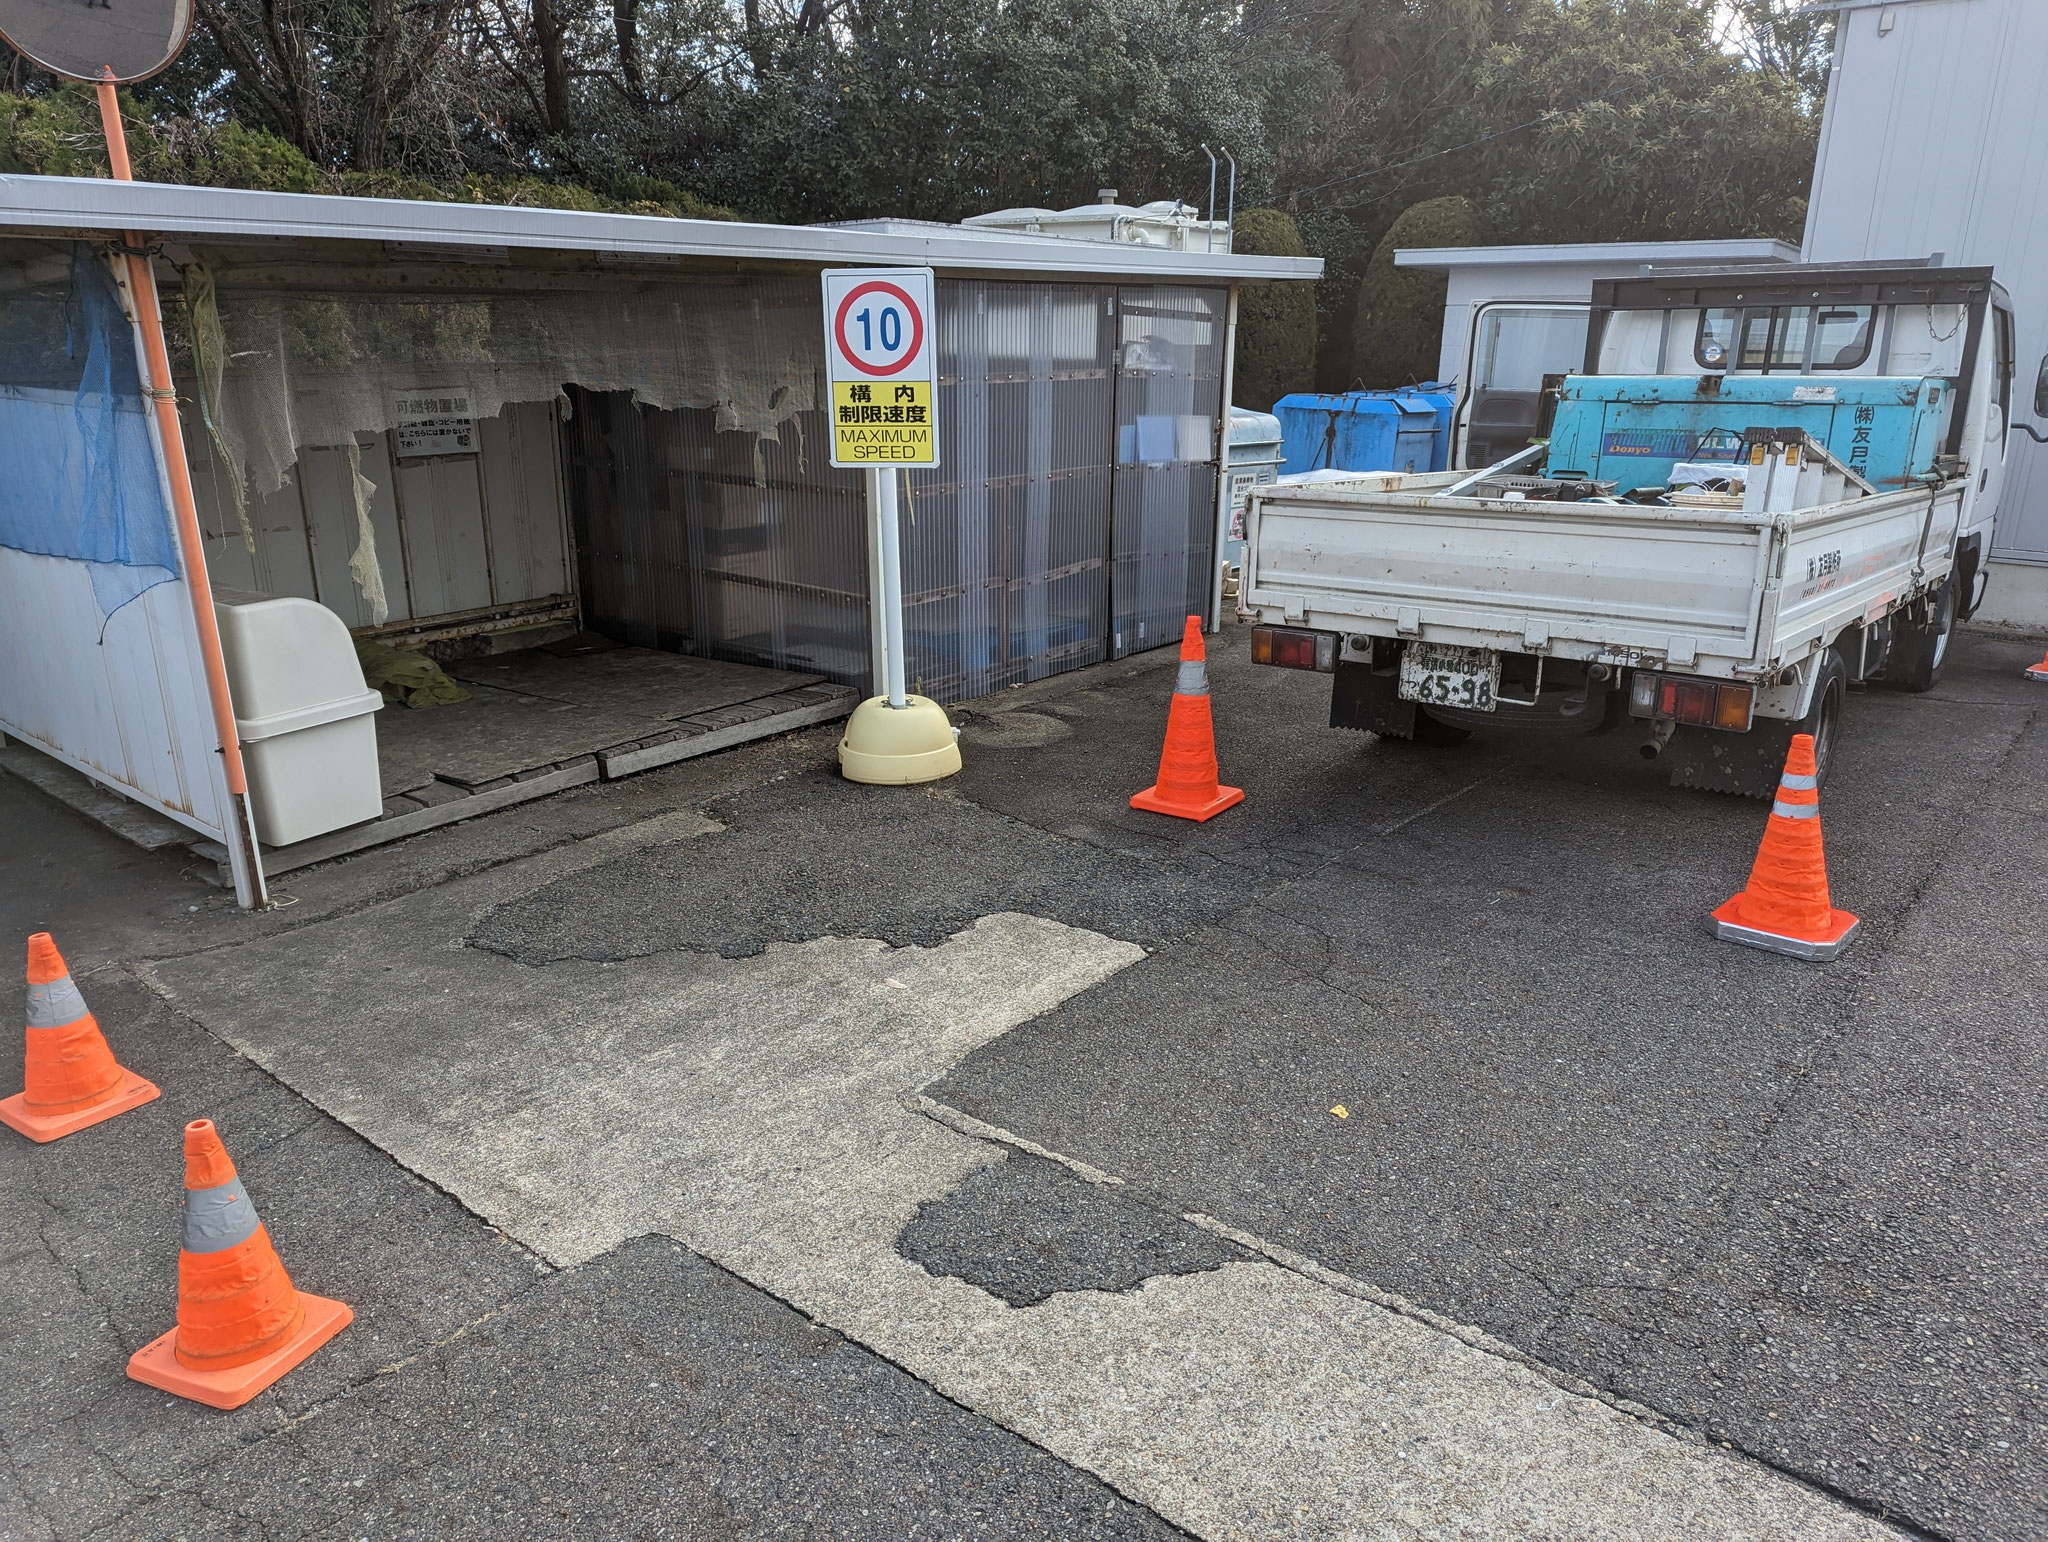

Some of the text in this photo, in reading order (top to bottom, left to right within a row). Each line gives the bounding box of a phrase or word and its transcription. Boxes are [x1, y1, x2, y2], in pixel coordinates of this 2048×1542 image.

[856, 307, 901, 351] 10
[839, 405, 927, 423] 制限速度
[841, 429, 927, 443] MAXIMUM
[854, 446, 916, 459] SPEED
[1420, 674, 1492, 707] 65-98
